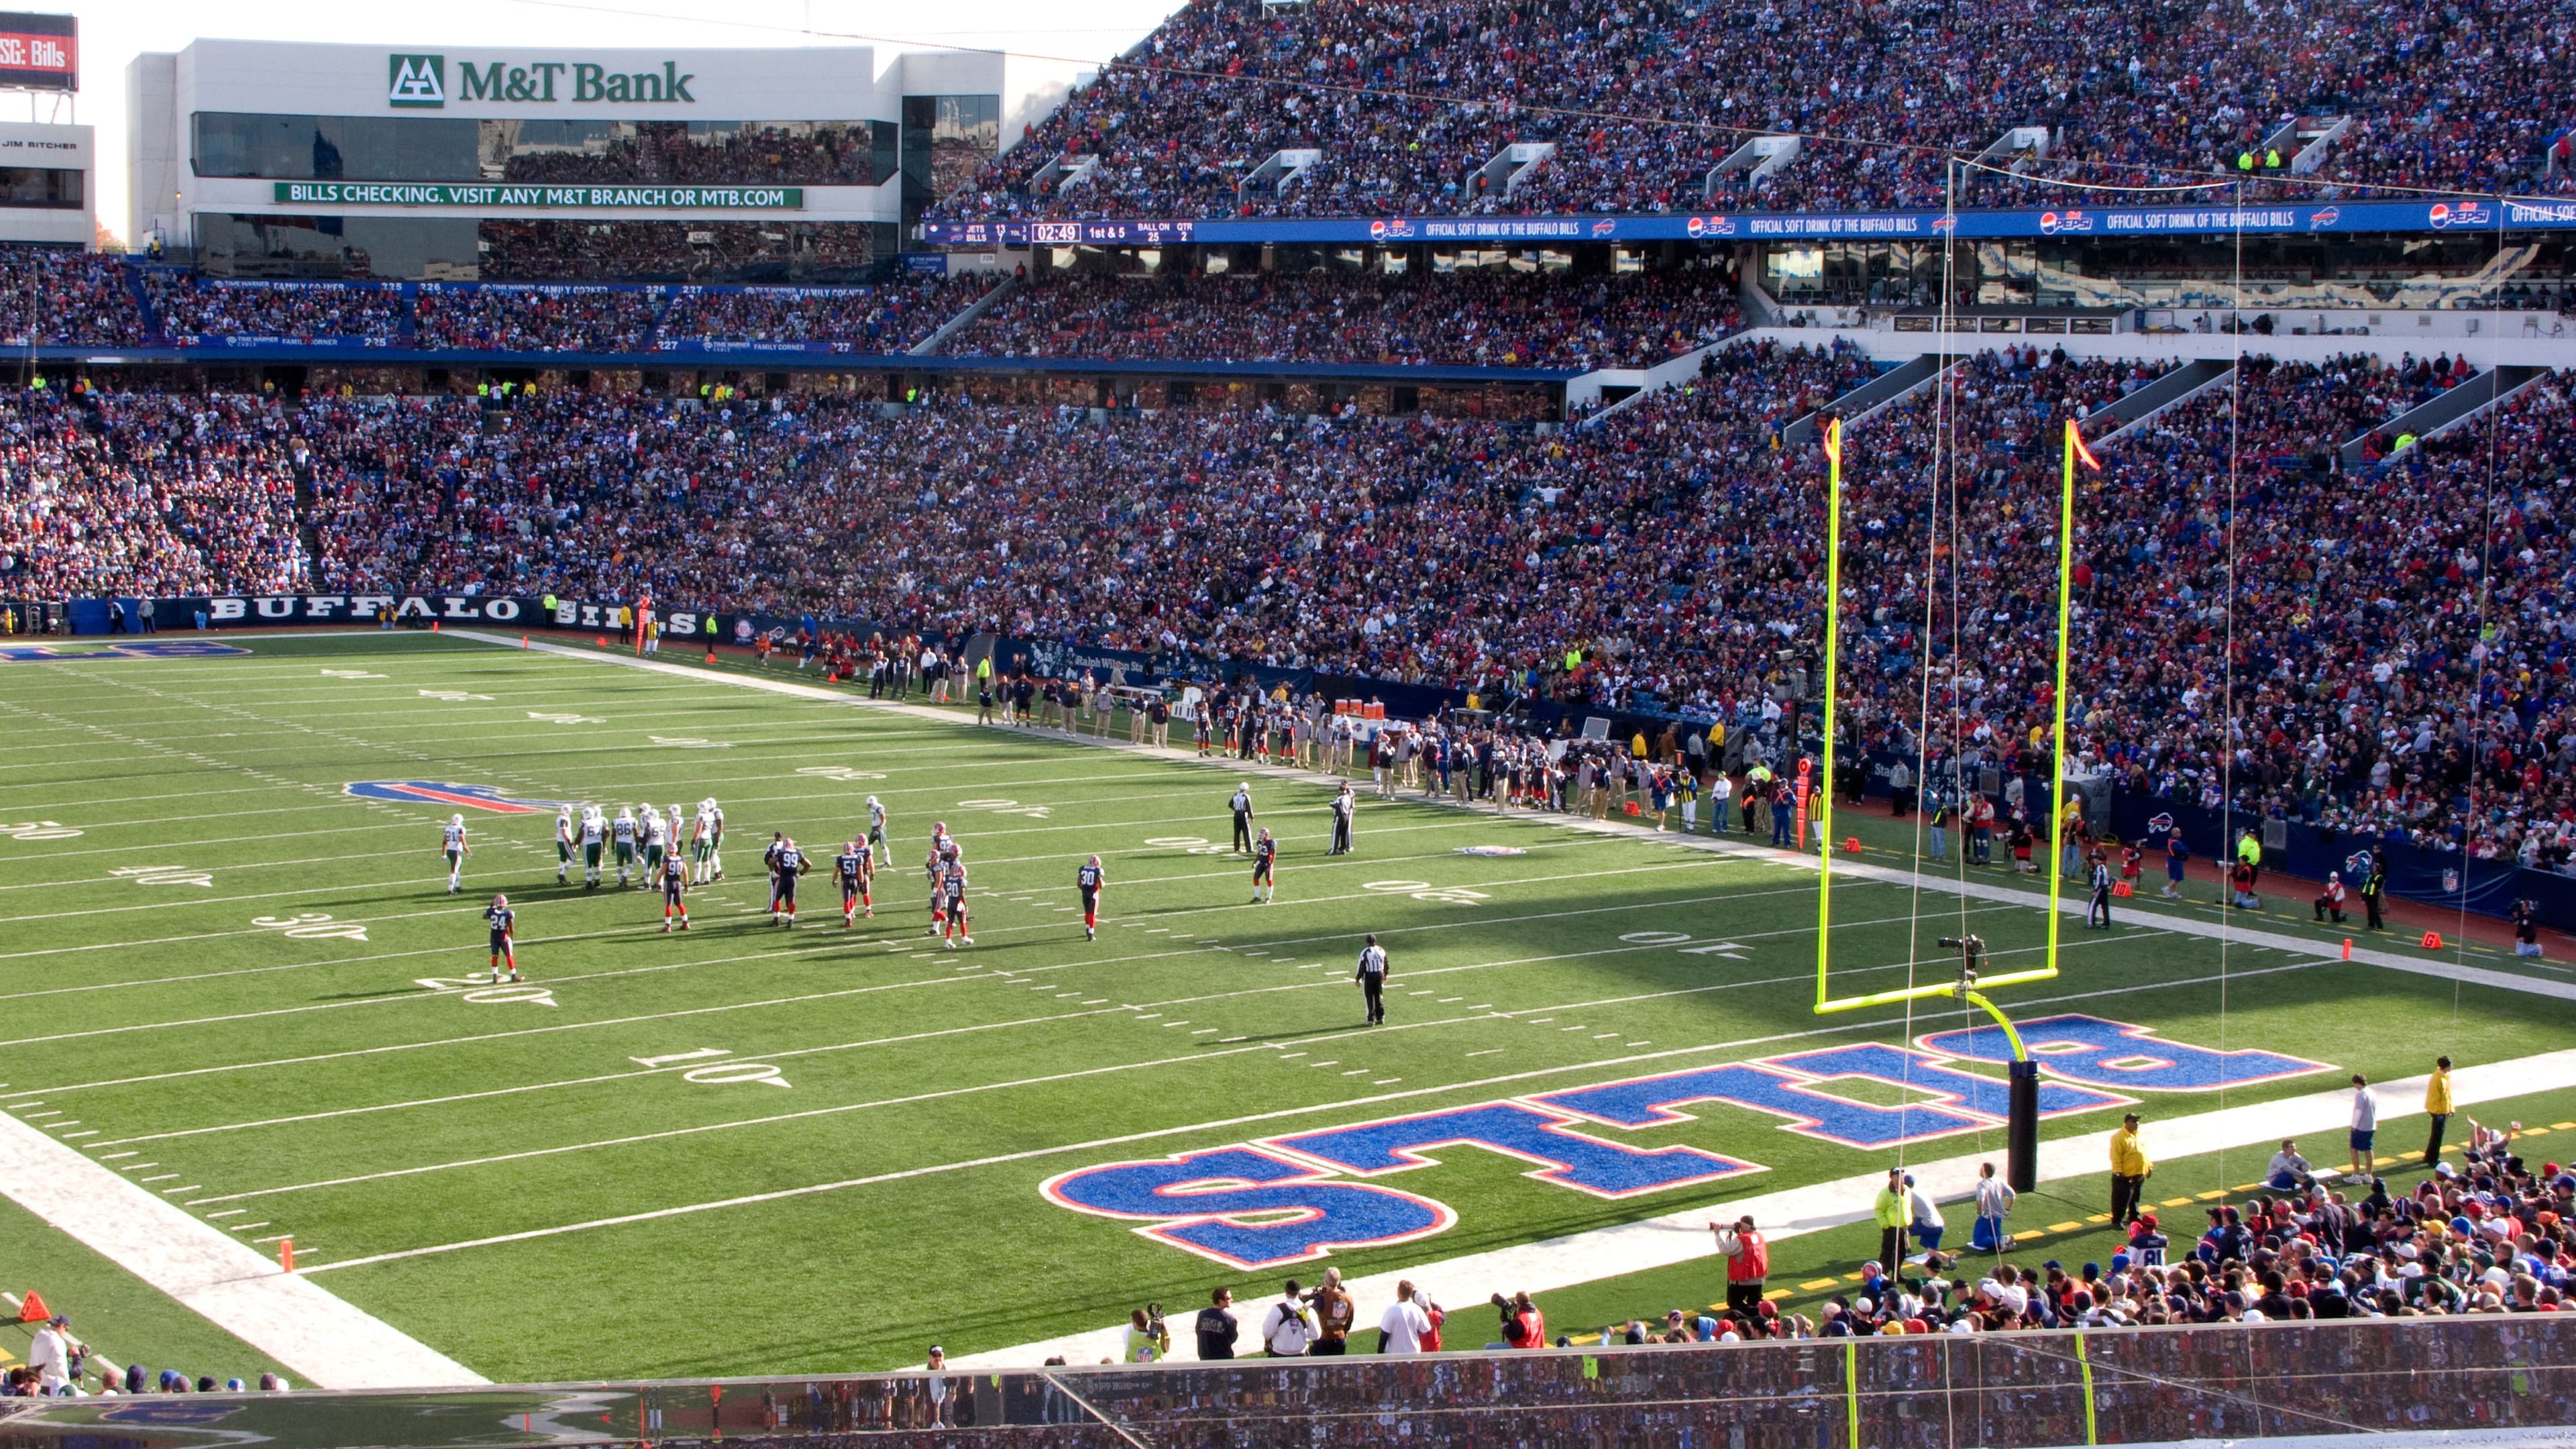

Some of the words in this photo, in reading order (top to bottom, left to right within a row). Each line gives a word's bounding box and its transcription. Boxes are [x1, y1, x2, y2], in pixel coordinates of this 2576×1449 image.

[32, 40, 65, 67] Bills
[458, 61, 565, 103] M&T
[572, 60, 696, 103] Bank
[290, 186, 337, 201] BILLS
[343, 186, 444, 202] CHECKING.
[449, 189, 495, 203] VISIT
[500, 189, 541, 204] ANY
[546, 189, 586, 205] M&T
[591, 190, 666, 205] BRANCH
[672, 190, 696, 205] OR
[702, 190, 784, 206] MTB.COM
[2107, 215, 2143, 229] OFFICIAL
[2145, 214, 2167, 229] SOFT
[2168, 213, 2196, 228] DRINK
[2197, 213, 2209, 227] OF
[2211, 213, 2228, 227] THE
[2229, 212, 2268, 227] BUFFALO
[2270, 211, 2294, 226] BILLS
[2447, 210, 2490, 223] PEPSI
[2512, 205, 2554, 222] OFFICIAL
[967, 225, 985, 233] JETS
[996, 224, 1006, 234] 13
[1138, 223, 1157, 231] BALL
[1159, 223, 1170, 231] ON
[1177, 223, 1193, 231] QTR
[1426, 223, 1456, 235] OFFICIAL
[1458, 223, 1475, 235] SOFT
[1477, 223, 1499, 235] DRINK
[1501, 223, 1510, 235] OF
[1512, 223, 1525, 235] THE
[1527, 223, 1558, 235] BUFFALO
[1560, 222, 1578, 235] BILLS
[1701, 222, 1735, 234] PEPSI
[1751, 219, 1784, 233] OFFICIAL
[1785, 219, 1803, 233] SOFT
[1806, 219, 1830, 233] DRINK
[1831, 219, 1842, 232] OF
[1844, 219, 1858, 231] THE
[1860, 218, 1894, 231] BUFFALO
[1896, 217, 1917, 231] BILLS
[2055, 217, 2092, 230] PEPSI
[966, 234, 987, 242] BILLS
[999, 234, 1004, 243] 7
[1038, 226, 1075, 240] 02:49
[1089, 227, 1105, 238] 1st
[1107, 227, 1116, 238] &
[1118, 227, 1125, 238] 5
[1148, 232, 1159, 242] 25
[1181, 231, 1187, 241] 2
[1383, 226, 1414, 237] PEPSI
[800, 288, 830, 297] FAMILY
[657, 341, 678, 350] 227
[210, 596, 519, 619] BUFFALO
[1075, 655, 1101, 669] Ralph
[1102, 658, 1129, 671] Wilon
[1131, 661, 1165, 675] Staum
[1226, 710, 1234, 719] 10
[1281, 720, 1292, 729] 29
[957, 799, 1053, 814] 40
[616, 823, 631, 836] 86
[783, 853, 798, 867] 99
[668, 861, 683, 875] 90
[843, 860, 857, 875] 51
[108, 865, 213, 885] 40
[1081, 870, 1095, 885] 30
[947, 882, 959, 897] 20
[1362, 880, 1491, 902] 20
[2116, 883, 2126, 895] 10
[251, 913, 367, 939] 30
[490, 914, 506, 930] 24
[1618, 931, 1755, 956] 10
[2424, 934, 2435, 947] G
[628, 1047, 782, 1084] 10
[1038, 1012, 2342, 1271] BILLS
[21, 1295, 33, 1317] G
[1138, 1354, 1152, 1362] NFL
